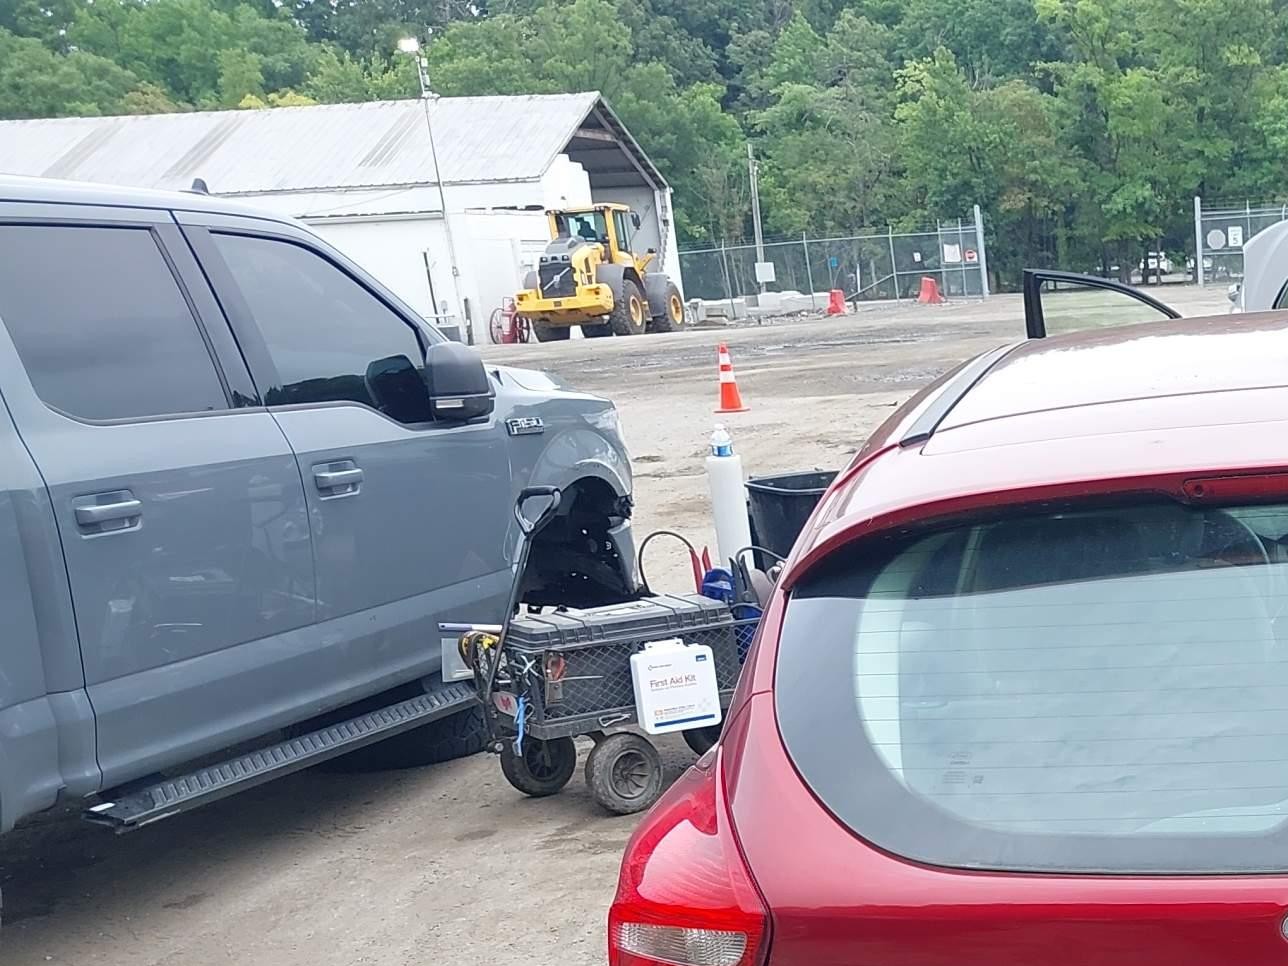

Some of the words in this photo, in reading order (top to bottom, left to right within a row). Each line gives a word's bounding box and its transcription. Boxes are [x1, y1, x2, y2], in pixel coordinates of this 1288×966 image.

[650, 679, 668, 688] First
[669, 676, 683, 685] Aid
[684, 674, 697, 684] Kit
